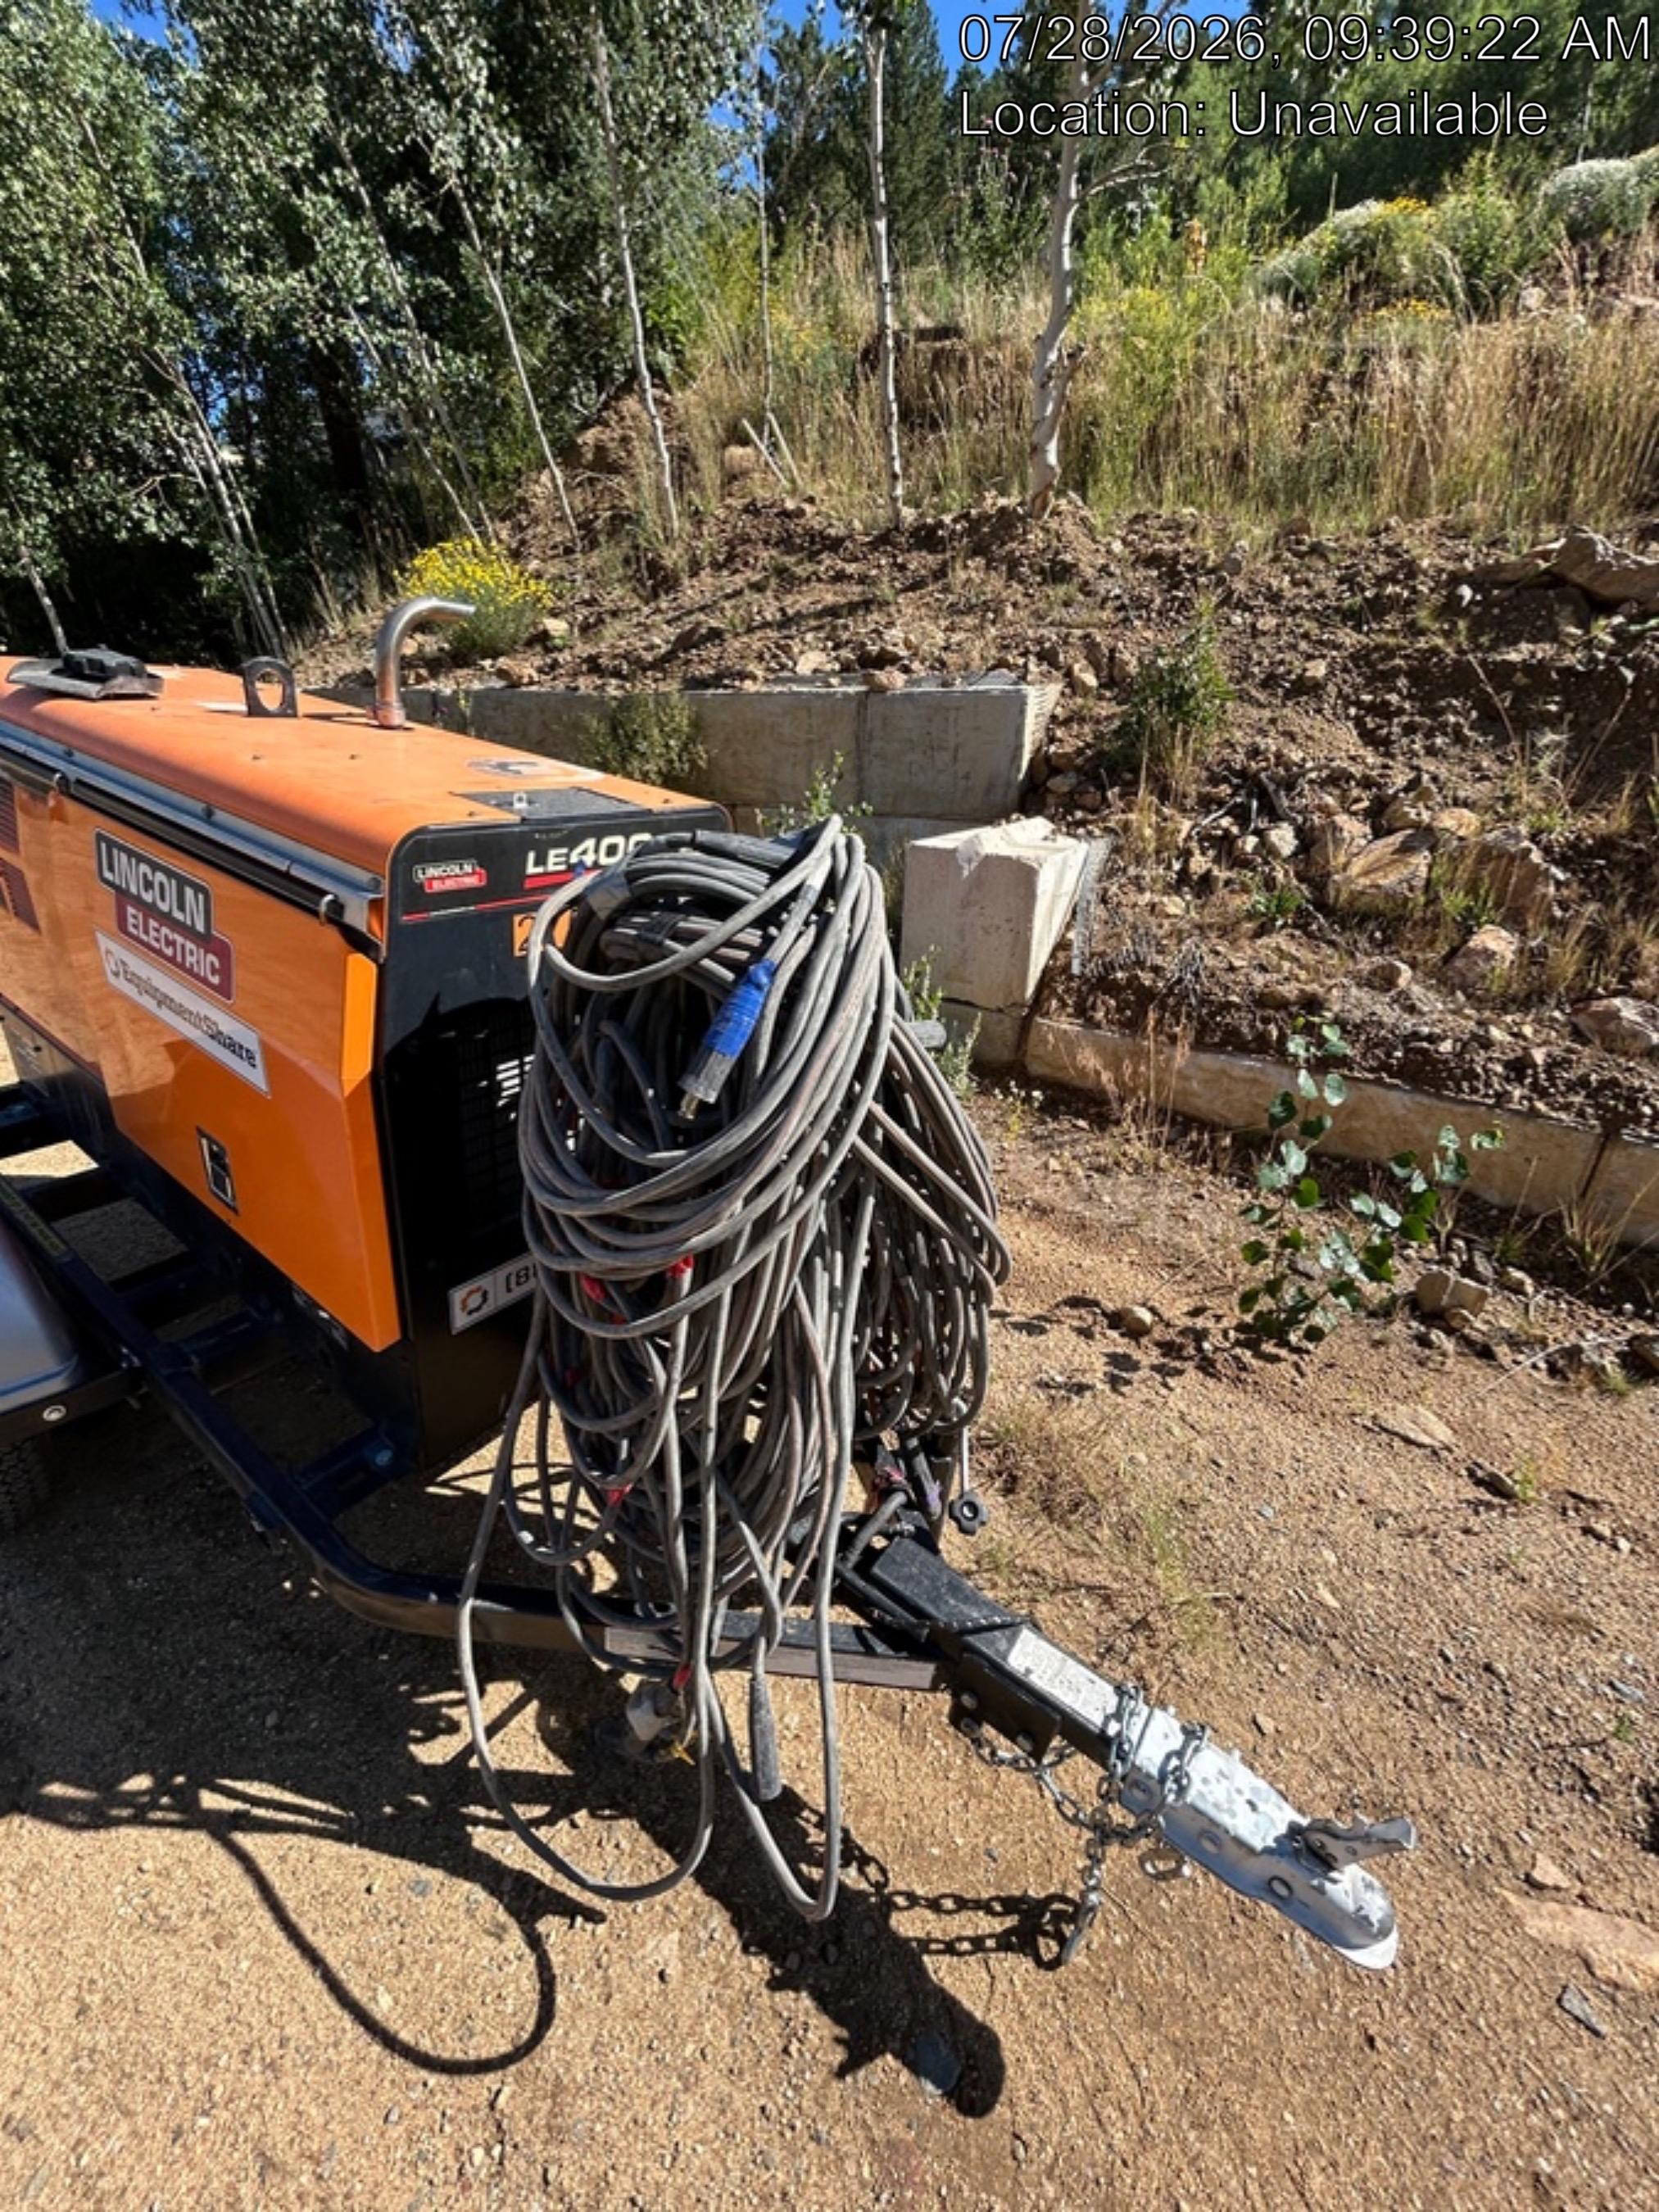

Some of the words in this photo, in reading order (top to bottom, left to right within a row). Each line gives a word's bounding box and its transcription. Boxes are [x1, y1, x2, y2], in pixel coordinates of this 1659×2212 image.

[100, 841, 205, 934] LINCOLN
[126, 905, 220, 985] ELECTRIC
[120, 958, 257, 1069] EquipmentShare
